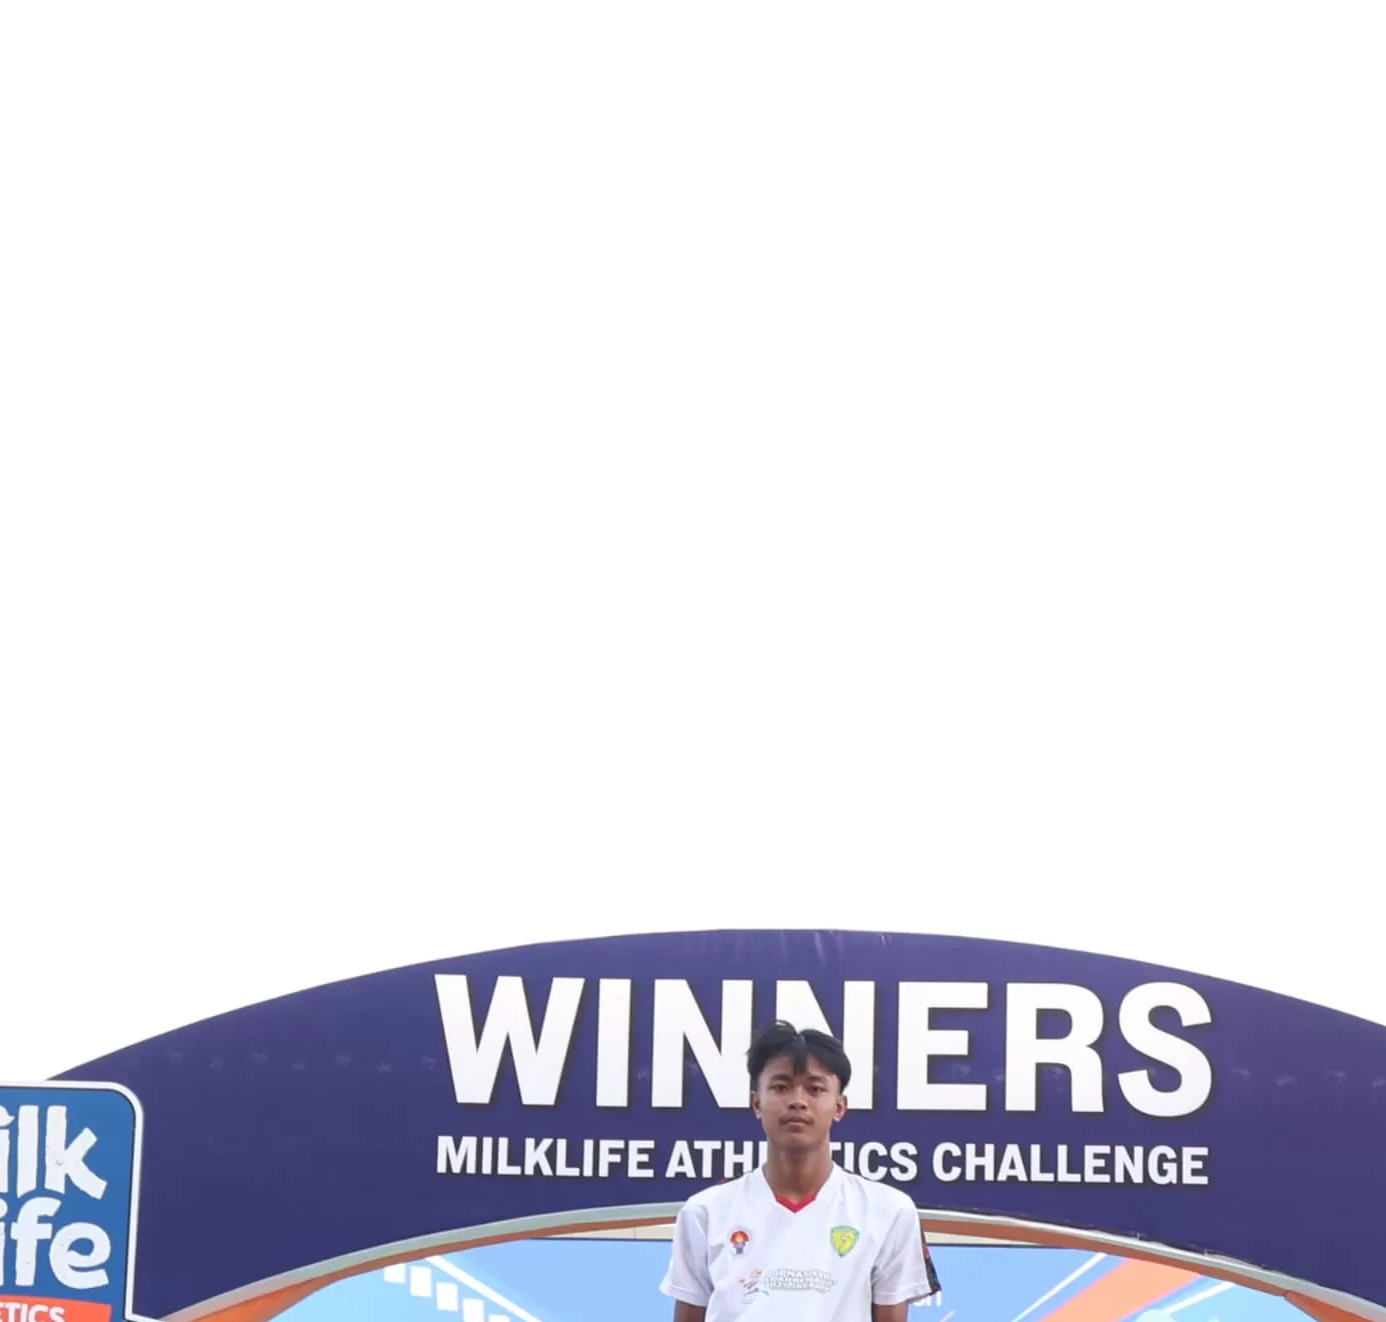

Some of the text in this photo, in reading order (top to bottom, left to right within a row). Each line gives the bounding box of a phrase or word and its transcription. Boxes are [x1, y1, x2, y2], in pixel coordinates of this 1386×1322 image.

[434, 973, 1214, 1118] WINNERS
[435, 1135, 1210, 1186] MILKLIFE ATHTICS CHALLENGE
